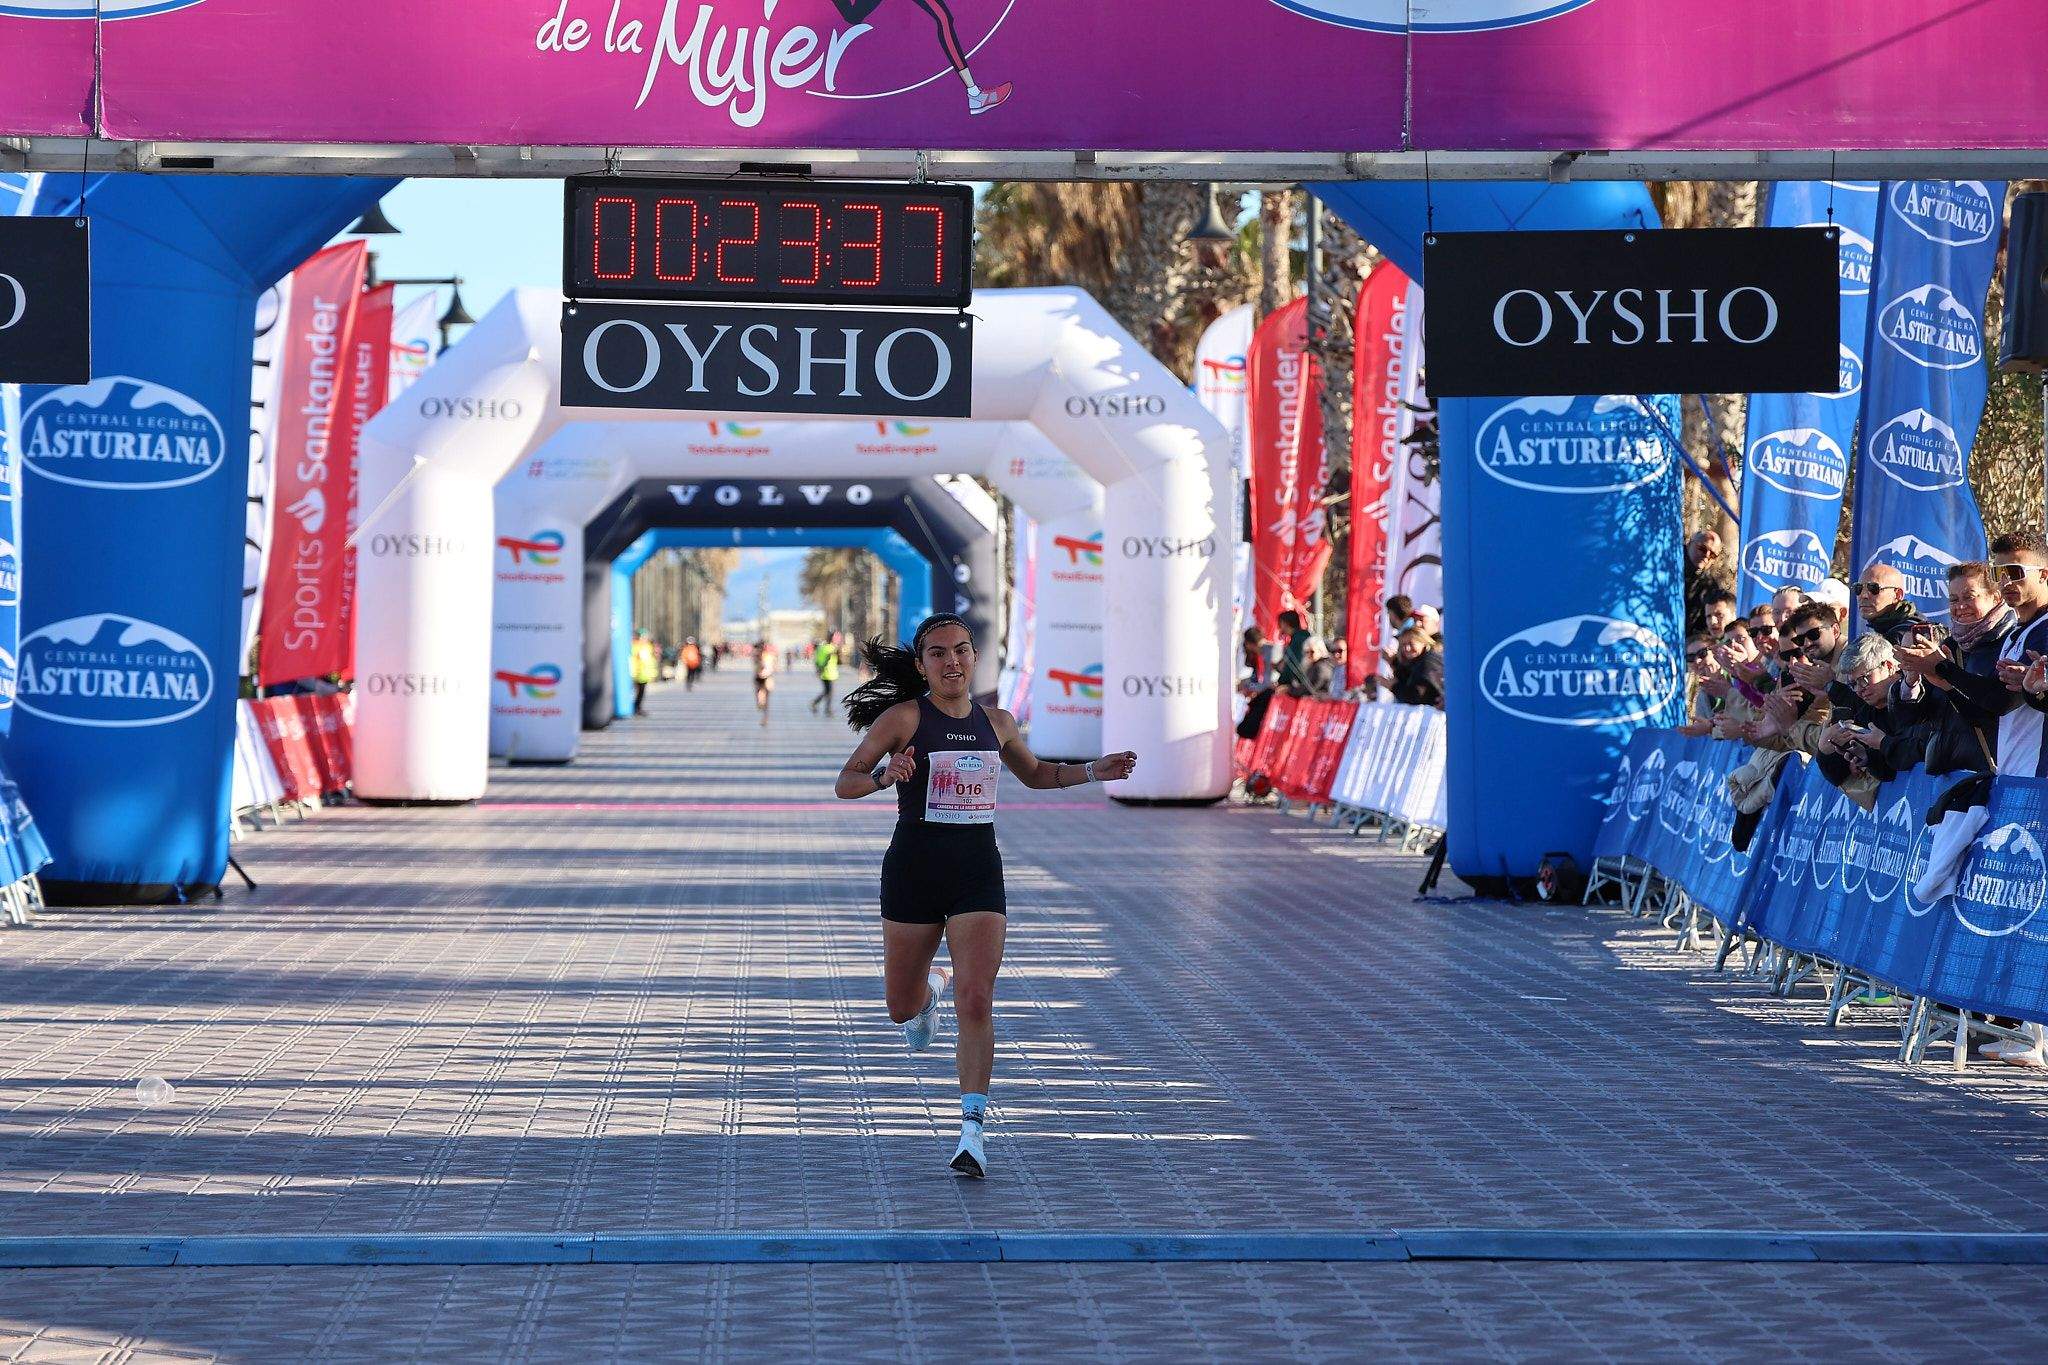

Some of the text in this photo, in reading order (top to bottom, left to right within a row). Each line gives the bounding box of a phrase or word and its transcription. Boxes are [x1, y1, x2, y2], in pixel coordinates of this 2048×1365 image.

[535, 0, 874, 128] de la Mujer
[593, 196, 945, 287] 00:23:37
[1492, 286, 1778, 347] OYSHO
[582, 318, 952, 401] OYSHO
[56, 412, 129, 427] CENTRAL
[420, 397, 522, 420] OYSHO
[1065, 395, 1166, 418] OYSHO
[1520, 421, 1594, 433] CENTRAL
[27, 414, 213, 466] ASTURIANA
[284, 295, 340, 651] Sports Santander
[1757, 445, 1844, 489] ASTURIANA
[666, 483, 873, 507] VOLVO
[16, 652, 201, 701] ASTURIANA
[44, 650, 197, 668] CENTRAL LECHERA
[1494, 656, 1669, 698] ASTURIANA
[1525, 653, 1596, 665] CENTRAL
[946, 732, 977, 742] OYSHO
[955, 783, 982, 796] 016
[1956, 857, 2040, 911] ASTURIANA
